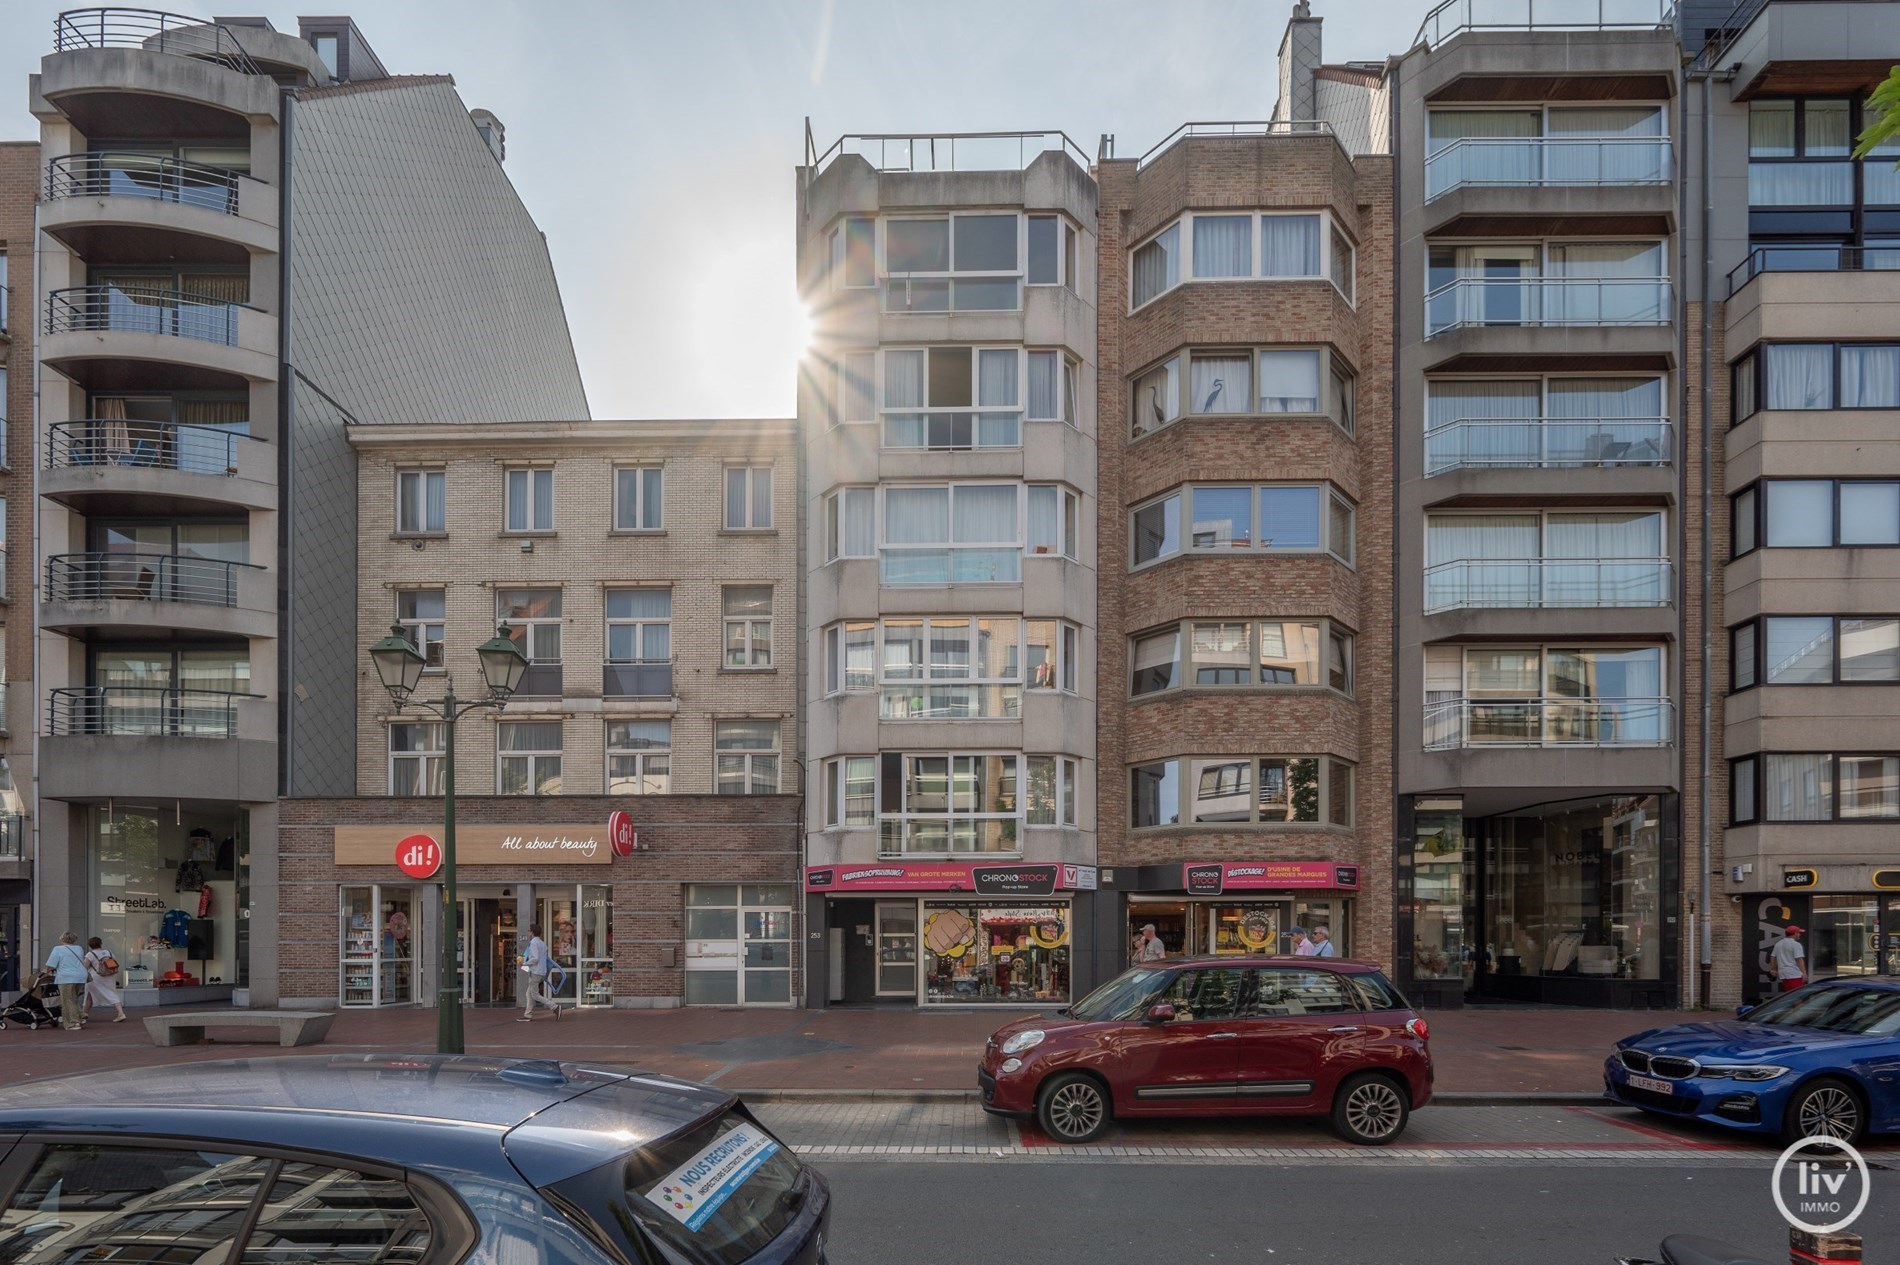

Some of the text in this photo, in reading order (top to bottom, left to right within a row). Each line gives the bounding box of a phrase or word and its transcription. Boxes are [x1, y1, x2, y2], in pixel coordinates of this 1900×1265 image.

[619, 823, 632, 845] di!
[403, 844, 434, 866] di!
[501, 836, 598, 857] All about beauty
[1786, 875, 1808, 883] CASH
[679, 1161, 712, 1188] NOUS
